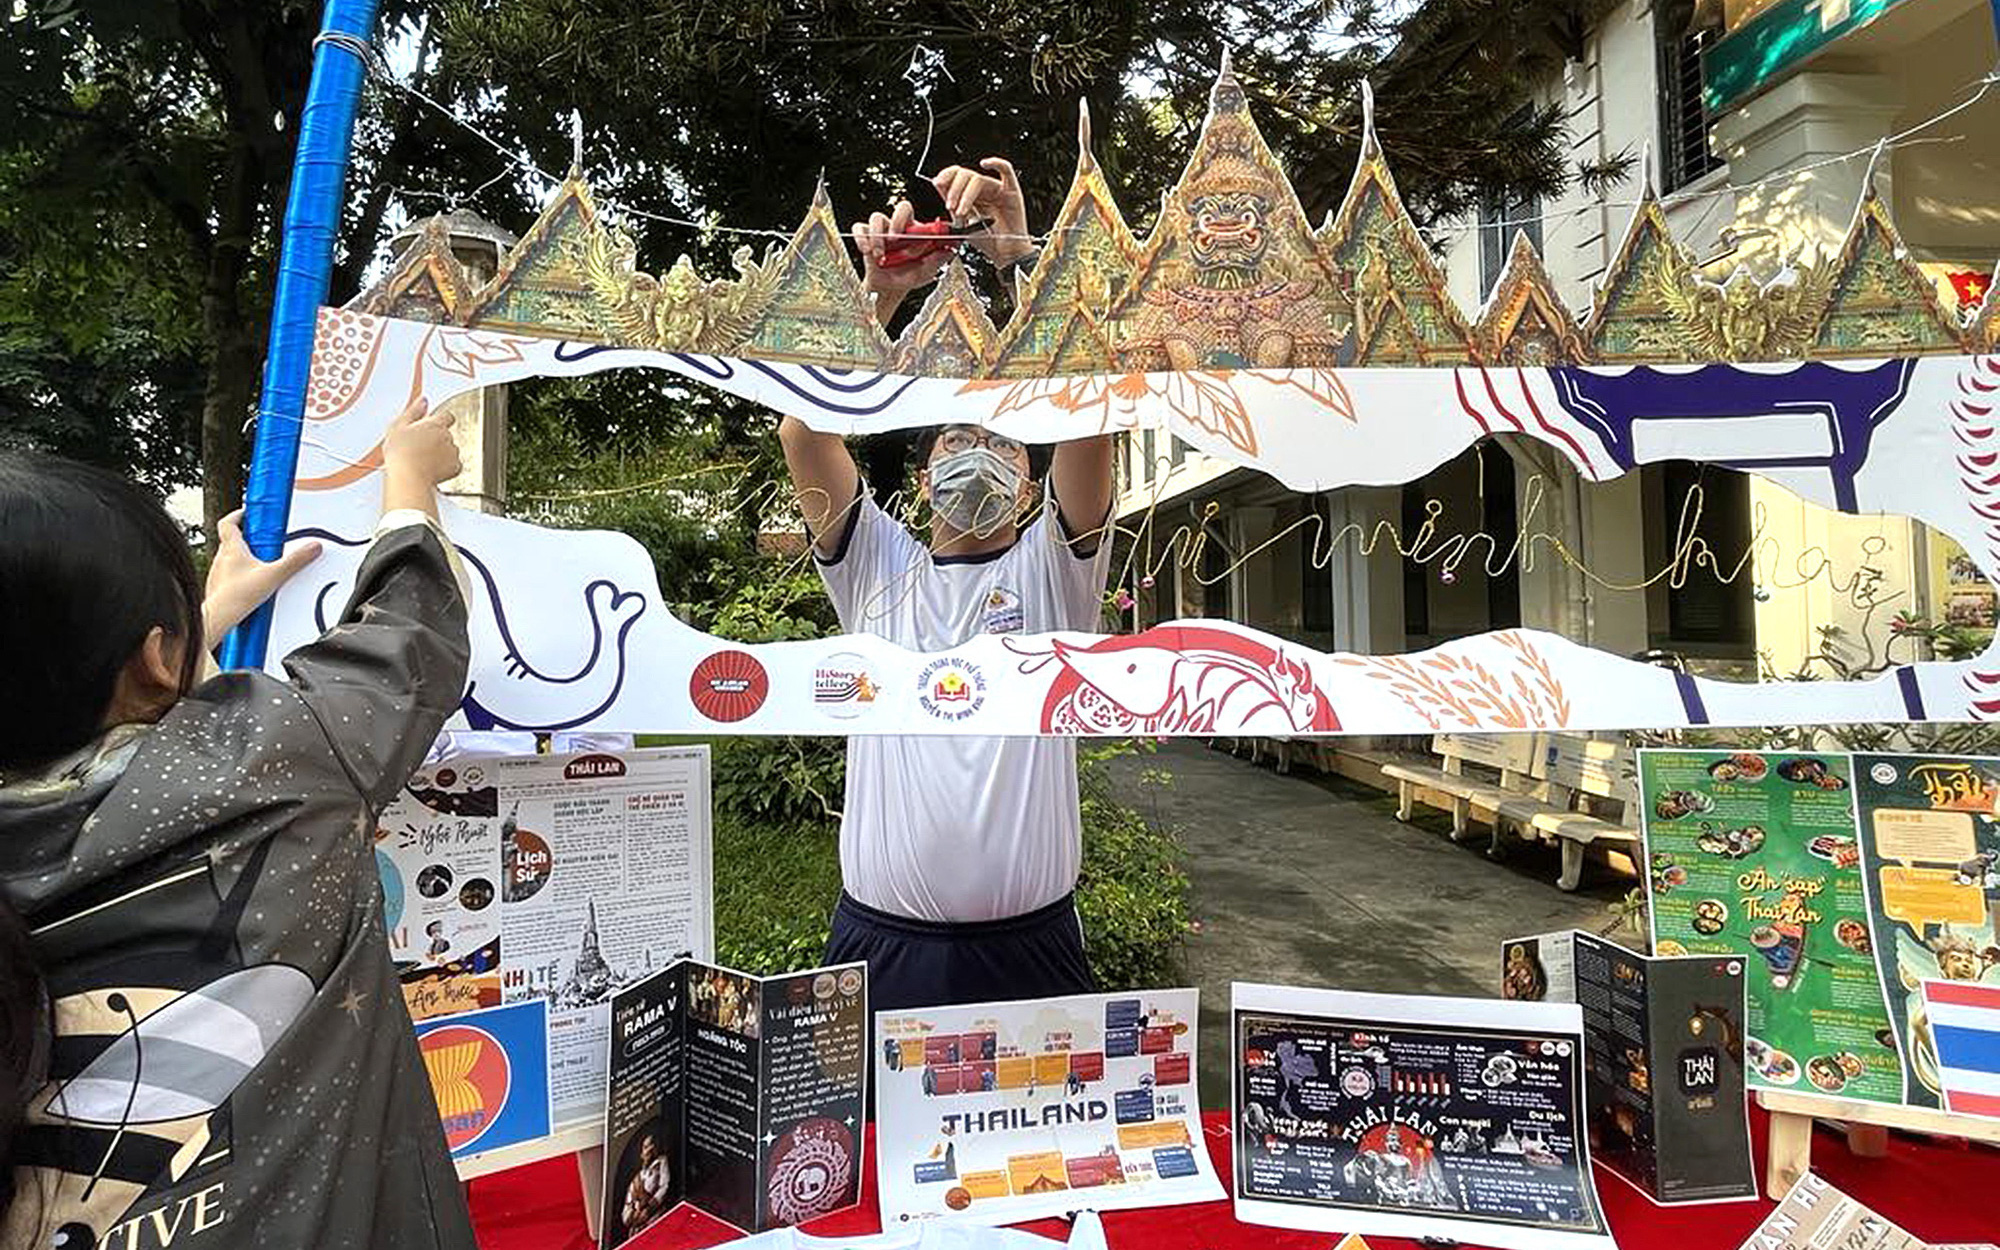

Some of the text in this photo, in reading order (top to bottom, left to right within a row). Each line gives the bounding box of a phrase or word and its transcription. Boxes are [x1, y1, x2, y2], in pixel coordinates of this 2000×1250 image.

[570, 761, 622, 776] THÁI LAN
[516, 851, 548, 868] Lịch
[516, 867, 541, 883] Sử
[624, 995, 677, 1037] RAMA V
[794, 1012, 839, 1028] RAMA V
[1684, 1054, 1715, 1073] THÁI
[1684, 1070, 1715, 1087] LAN
[941, 1100, 1108, 1135] THAILAND
[1393, 1106, 1438, 1138] LAN
[1438, 1115, 1460, 1126] Con
[1528, 1110, 1545, 1121] Du
